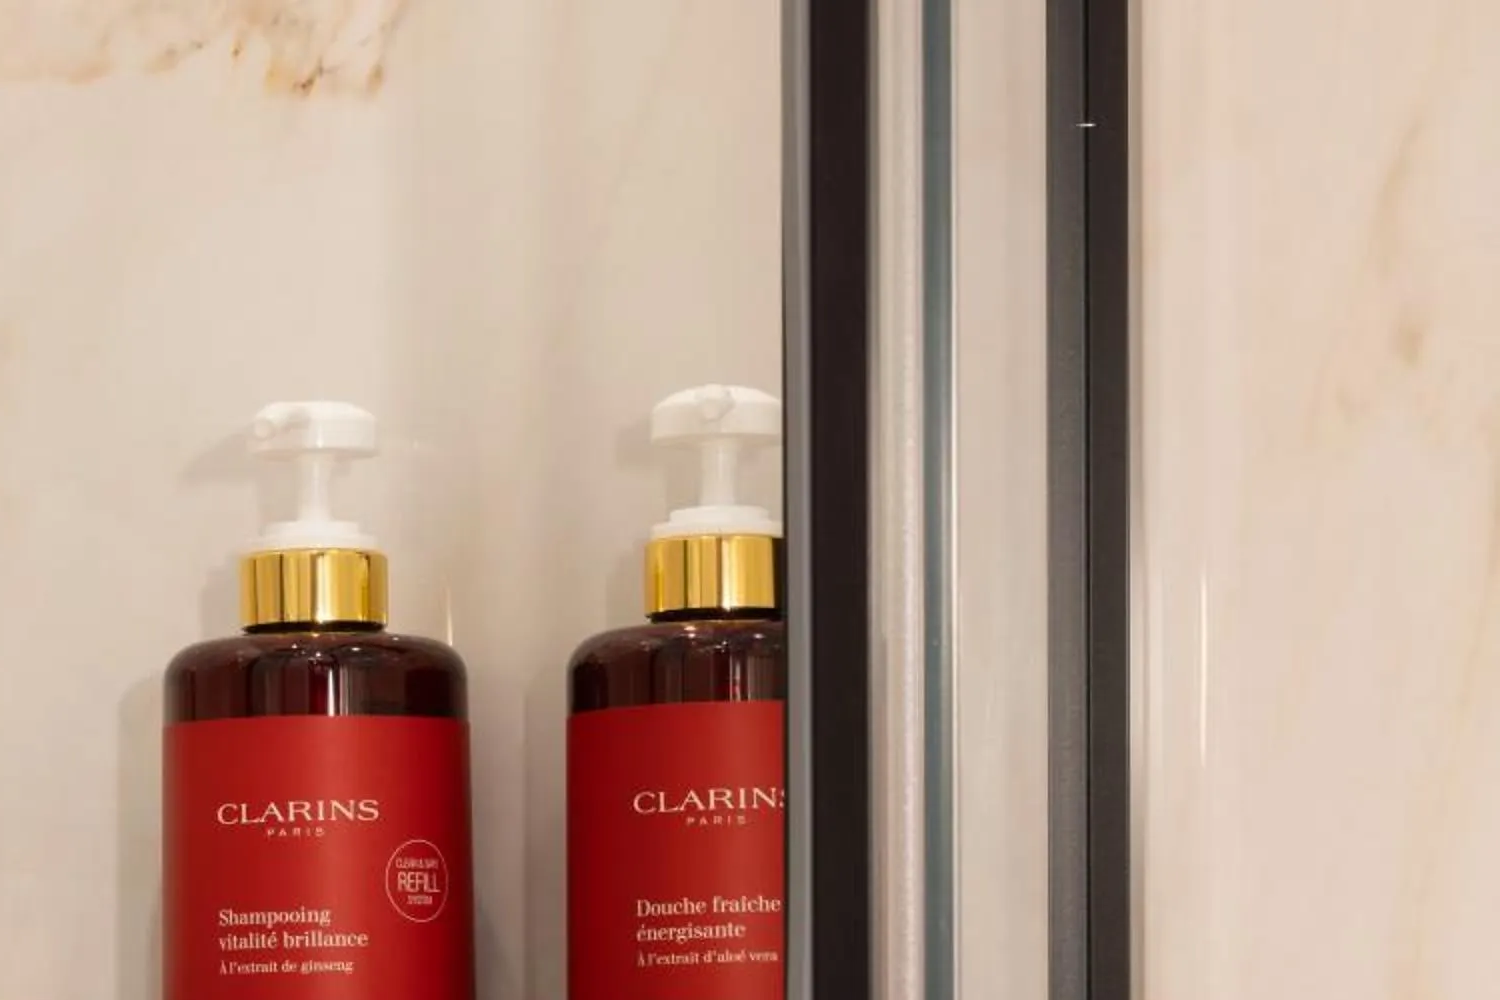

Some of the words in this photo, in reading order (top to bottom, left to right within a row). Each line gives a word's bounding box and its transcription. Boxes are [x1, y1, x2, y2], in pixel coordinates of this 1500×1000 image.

[217, 799, 380, 825] CLARINS
[686, 815, 747, 826] PARIS
[267, 828, 325, 837] PARIS
[398, 872, 440, 893] REFILL
[637, 897, 707, 917] Douche
[219, 906, 332, 929] Shampooing
[220, 931, 278, 950] vitalité
[283, 930, 369, 948] brillance
[636, 922, 746, 944] énergisante
[748, 951, 778, 962] vera
[281, 960, 297, 972] de
[301, 960, 354, 975] ginseng
